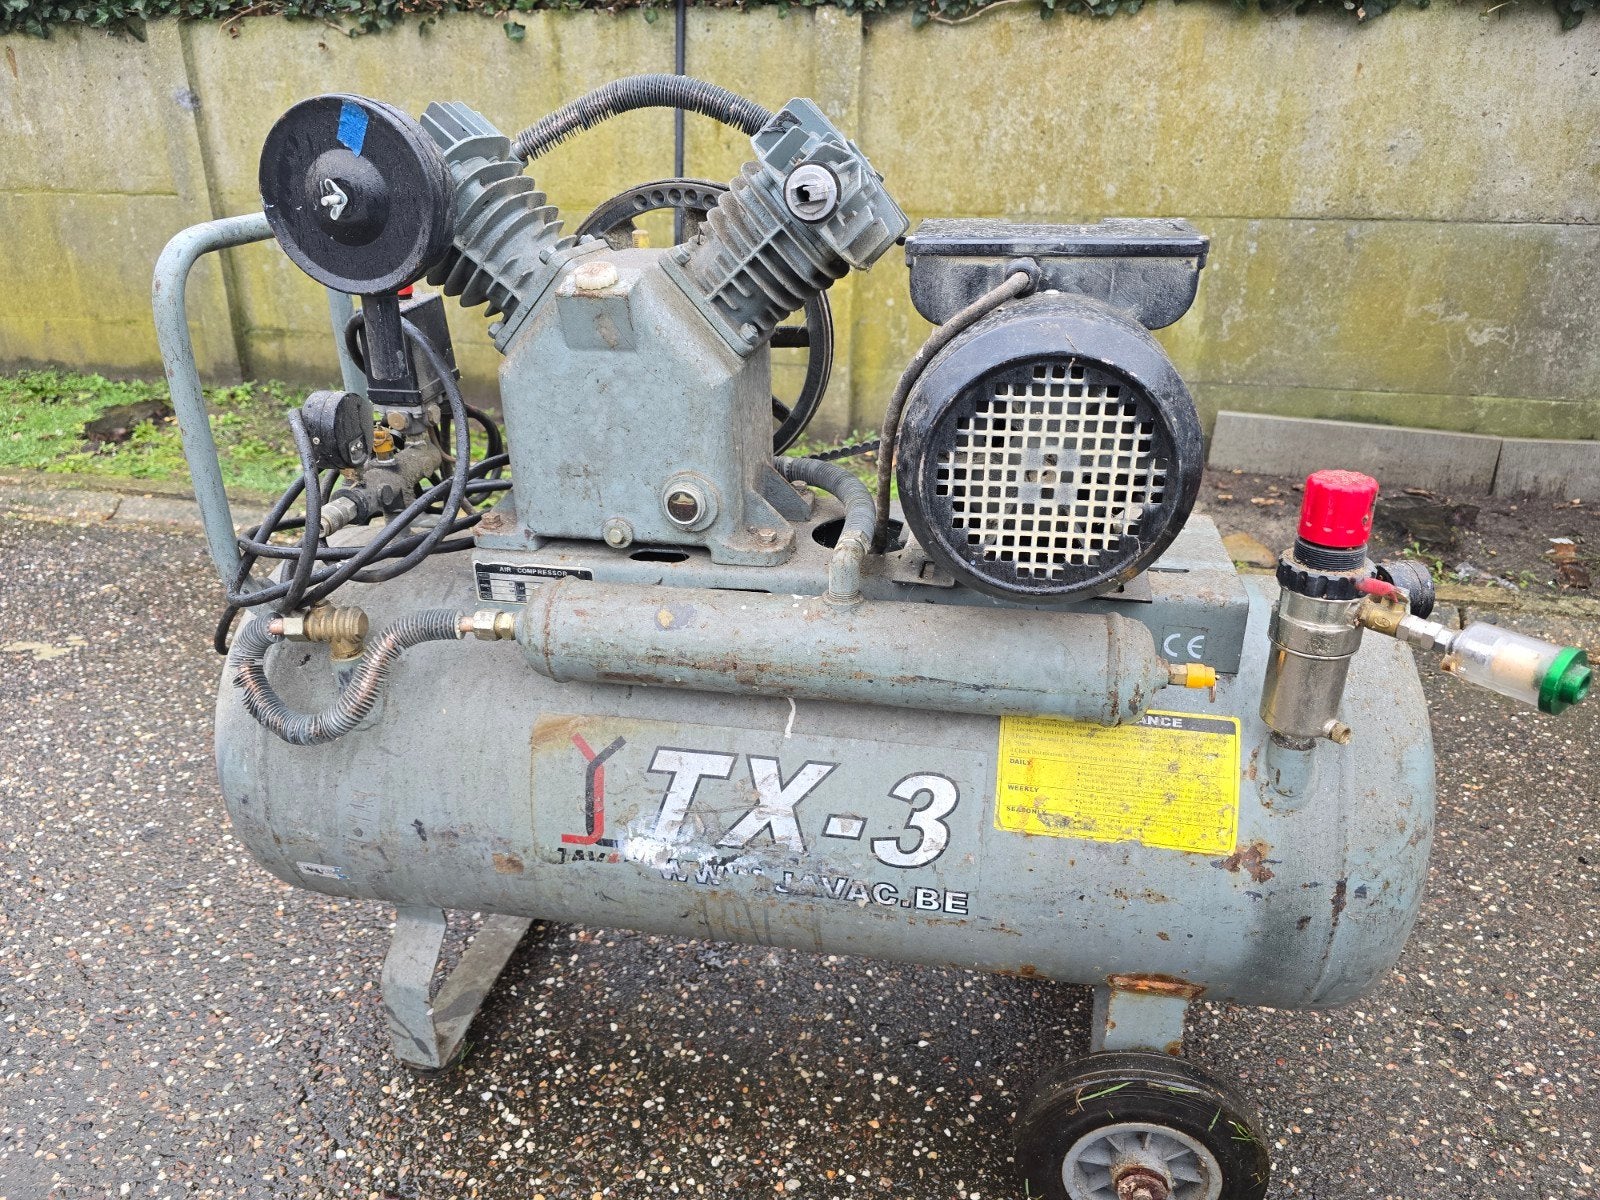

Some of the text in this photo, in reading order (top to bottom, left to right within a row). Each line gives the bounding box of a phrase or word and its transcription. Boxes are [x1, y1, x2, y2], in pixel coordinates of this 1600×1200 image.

[516, 567, 568, 577] COMPRESSOR
[1163, 633, 1206, 660] CE
[1009, 758, 1033, 766] DAILY
[1007, 784, 1040, 793] WEEKLY
[646, 745, 961, 869] TX-3
